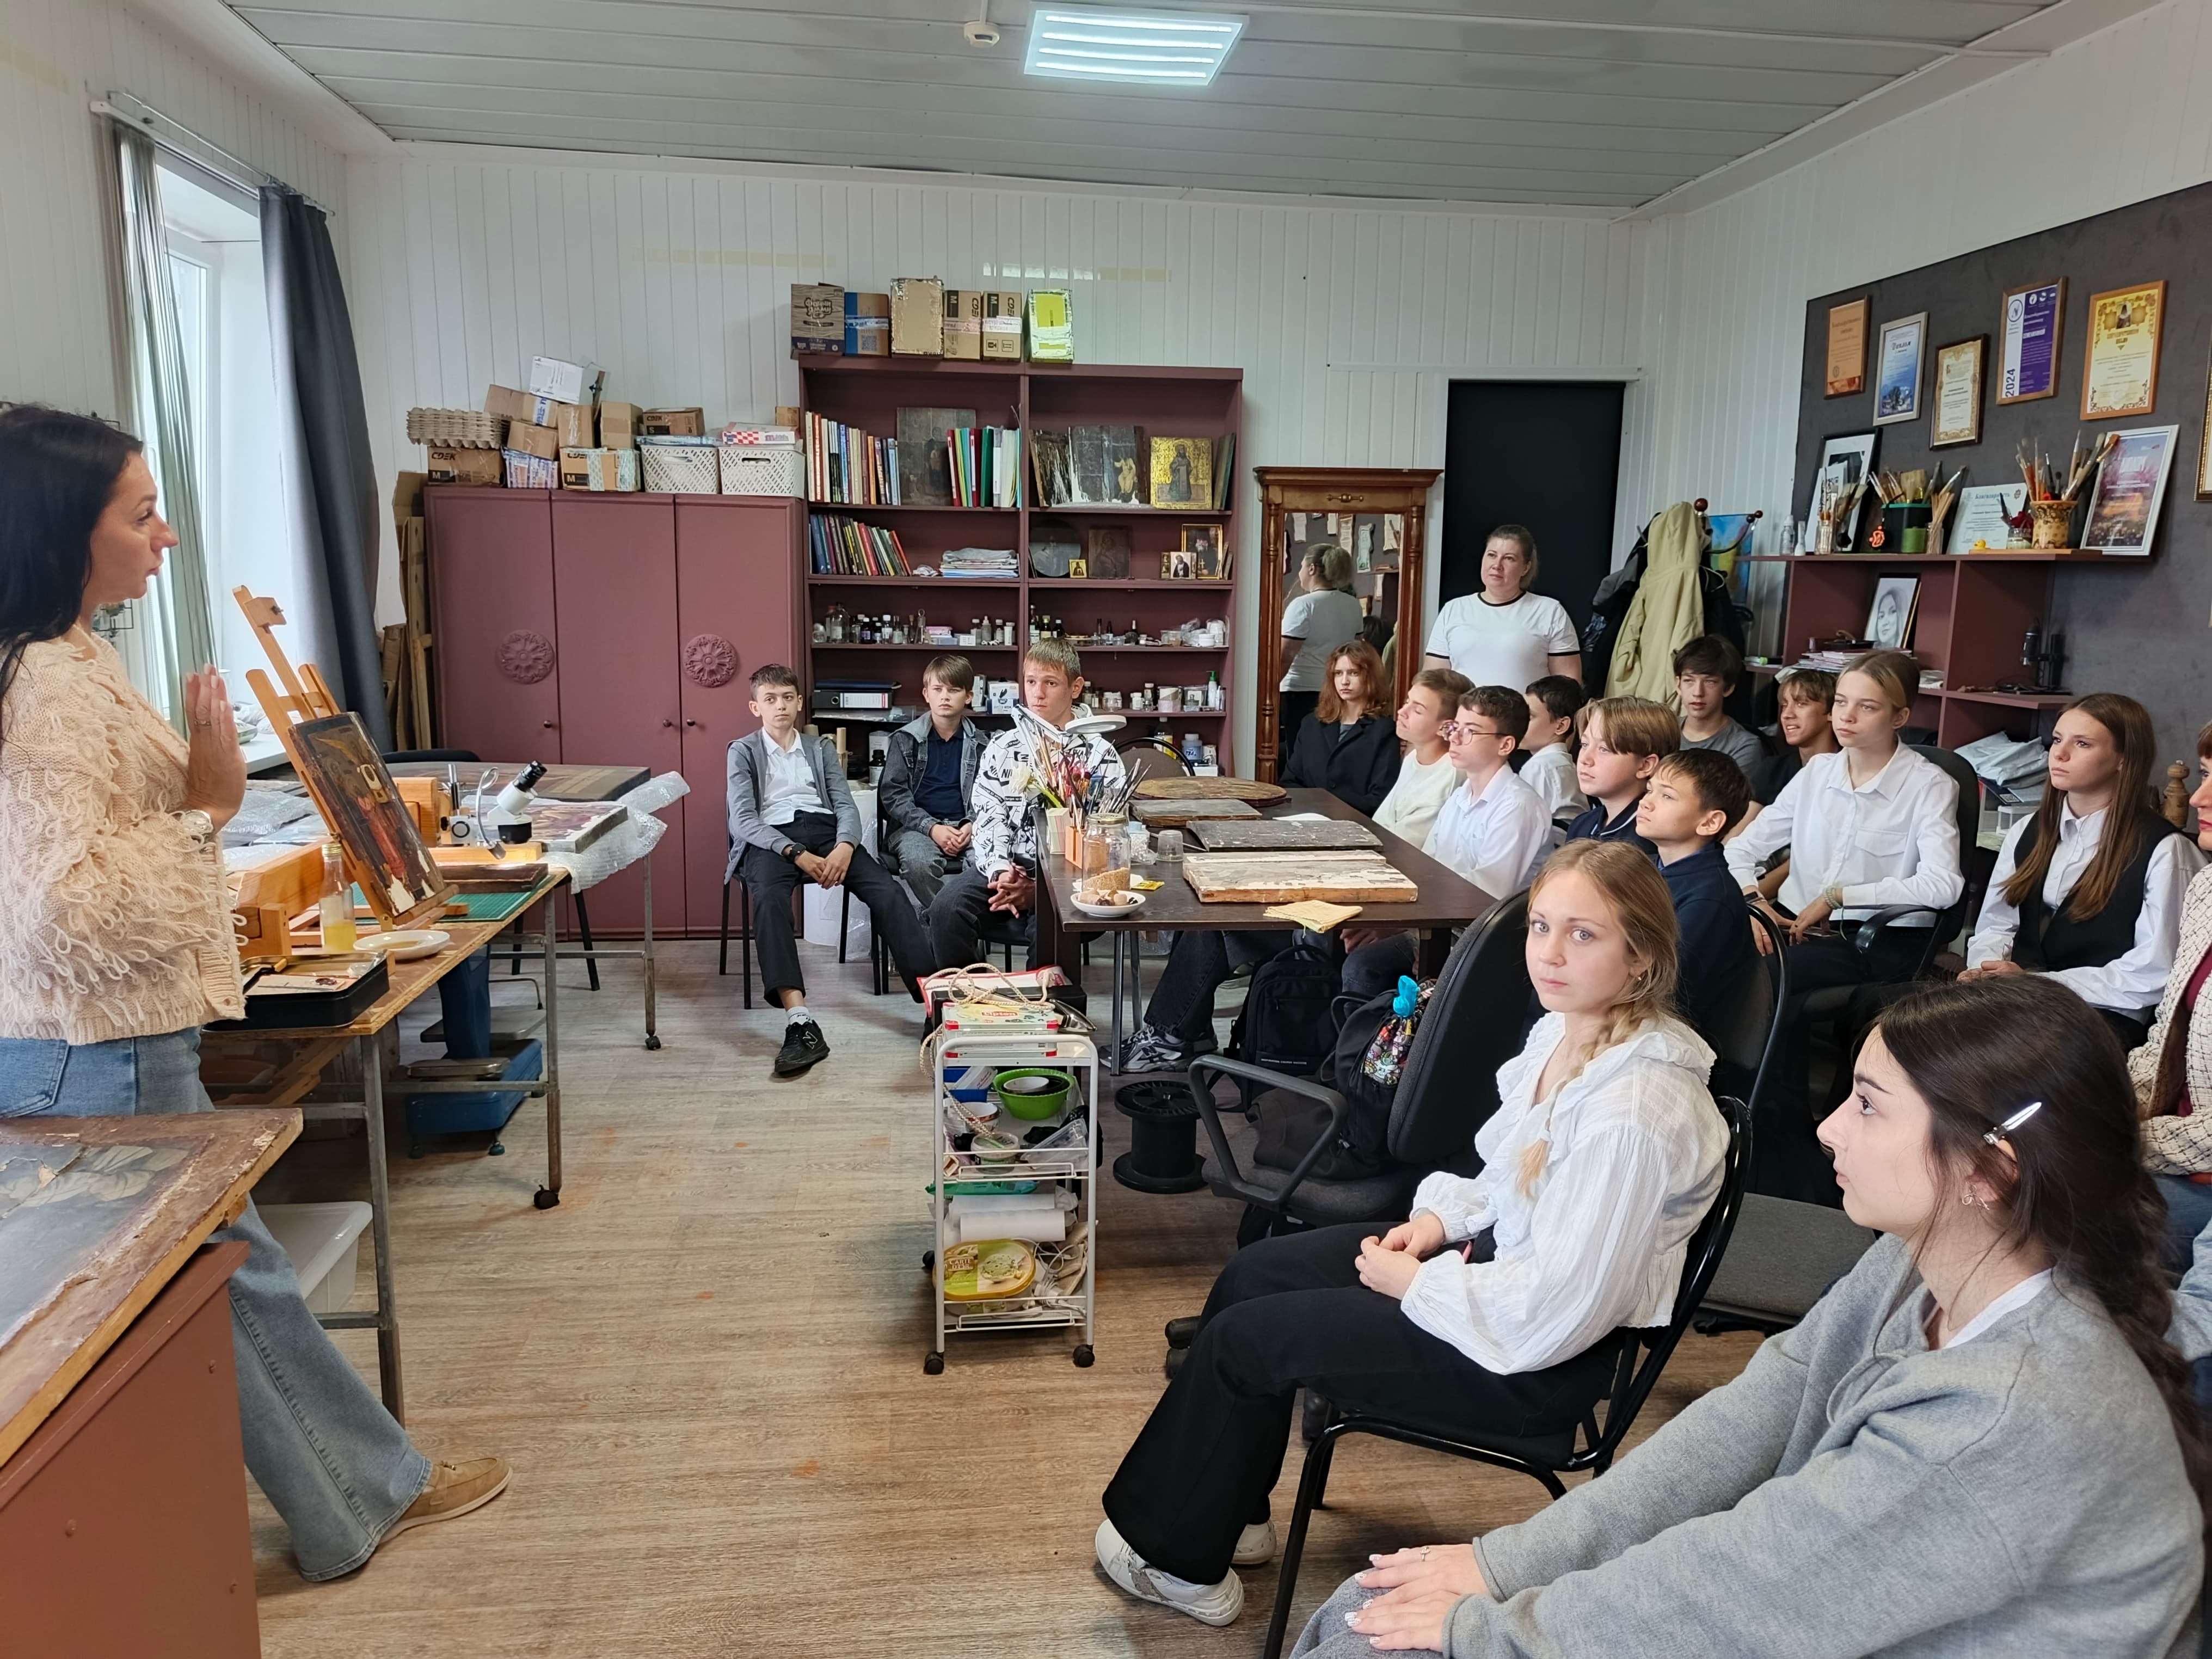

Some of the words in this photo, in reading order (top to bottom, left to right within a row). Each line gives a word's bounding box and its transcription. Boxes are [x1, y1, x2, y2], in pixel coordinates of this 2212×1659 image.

[950, 296, 957, 304] M
[991, 296, 997, 304] M
[2005, 368, 2015, 397] 2024
[432, 452, 456, 460] CDEK
[432, 471, 440, 480] M
